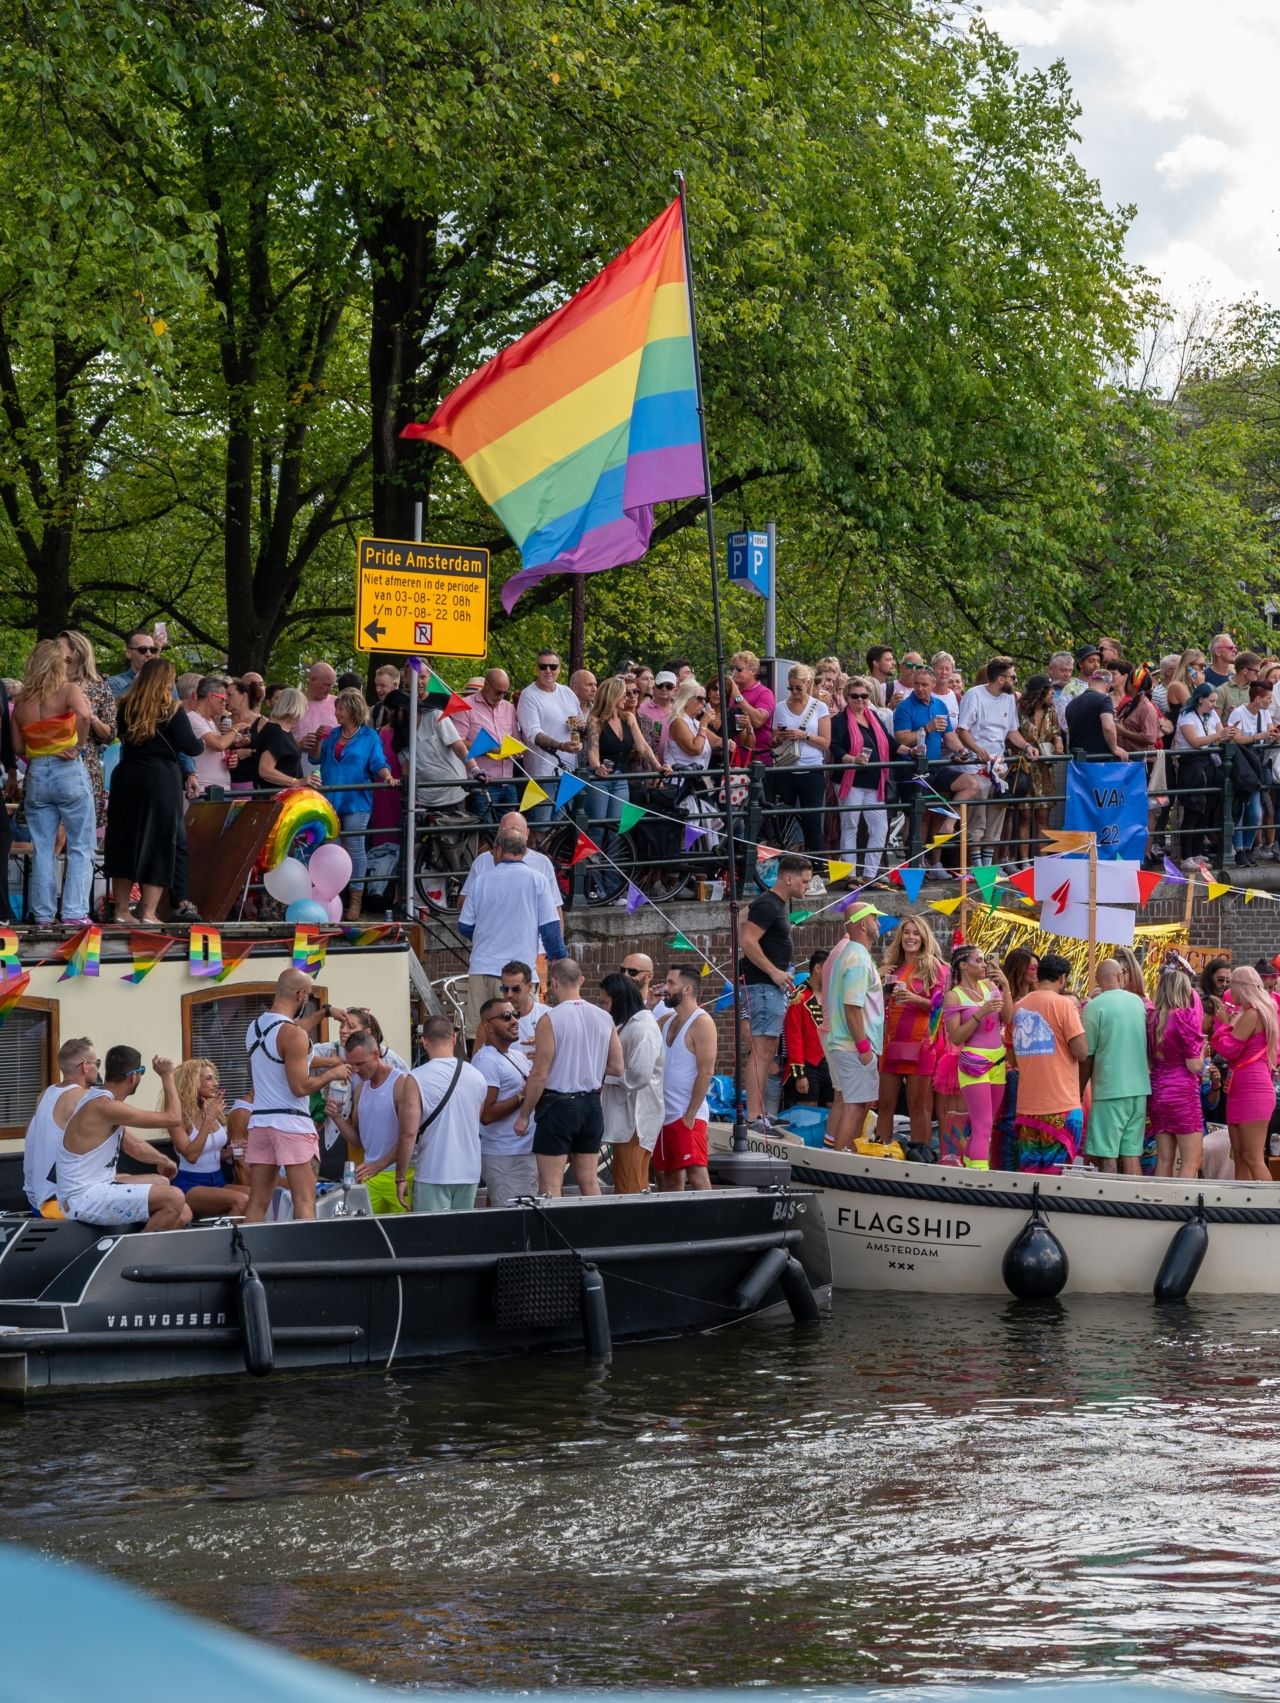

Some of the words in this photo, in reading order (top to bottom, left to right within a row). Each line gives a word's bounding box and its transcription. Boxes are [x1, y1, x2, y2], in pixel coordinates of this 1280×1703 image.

[366, 548, 401, 566] Pride
[406, 552, 482, 573] Amsterdam
[733, 550, 743, 576] P
[754, 550, 763, 575] P
[364, 574, 382, 584] Niet
[385, 576, 421, 588] afmeren
[424, 580, 432, 589] in
[435, 580, 445, 590] de
[375, 592, 391, 601] van
[453, 595, 470, 607] 08h
[373, 604, 392, 616] t/m
[453, 610, 471, 621] 08h
[1100, 824, 1119, 845] 22
[772, 1200, 796, 1220] BAS
[838, 1207, 971, 1239] FLAGSHIP
[866, 1241, 939, 1257] AMSTERDAM
